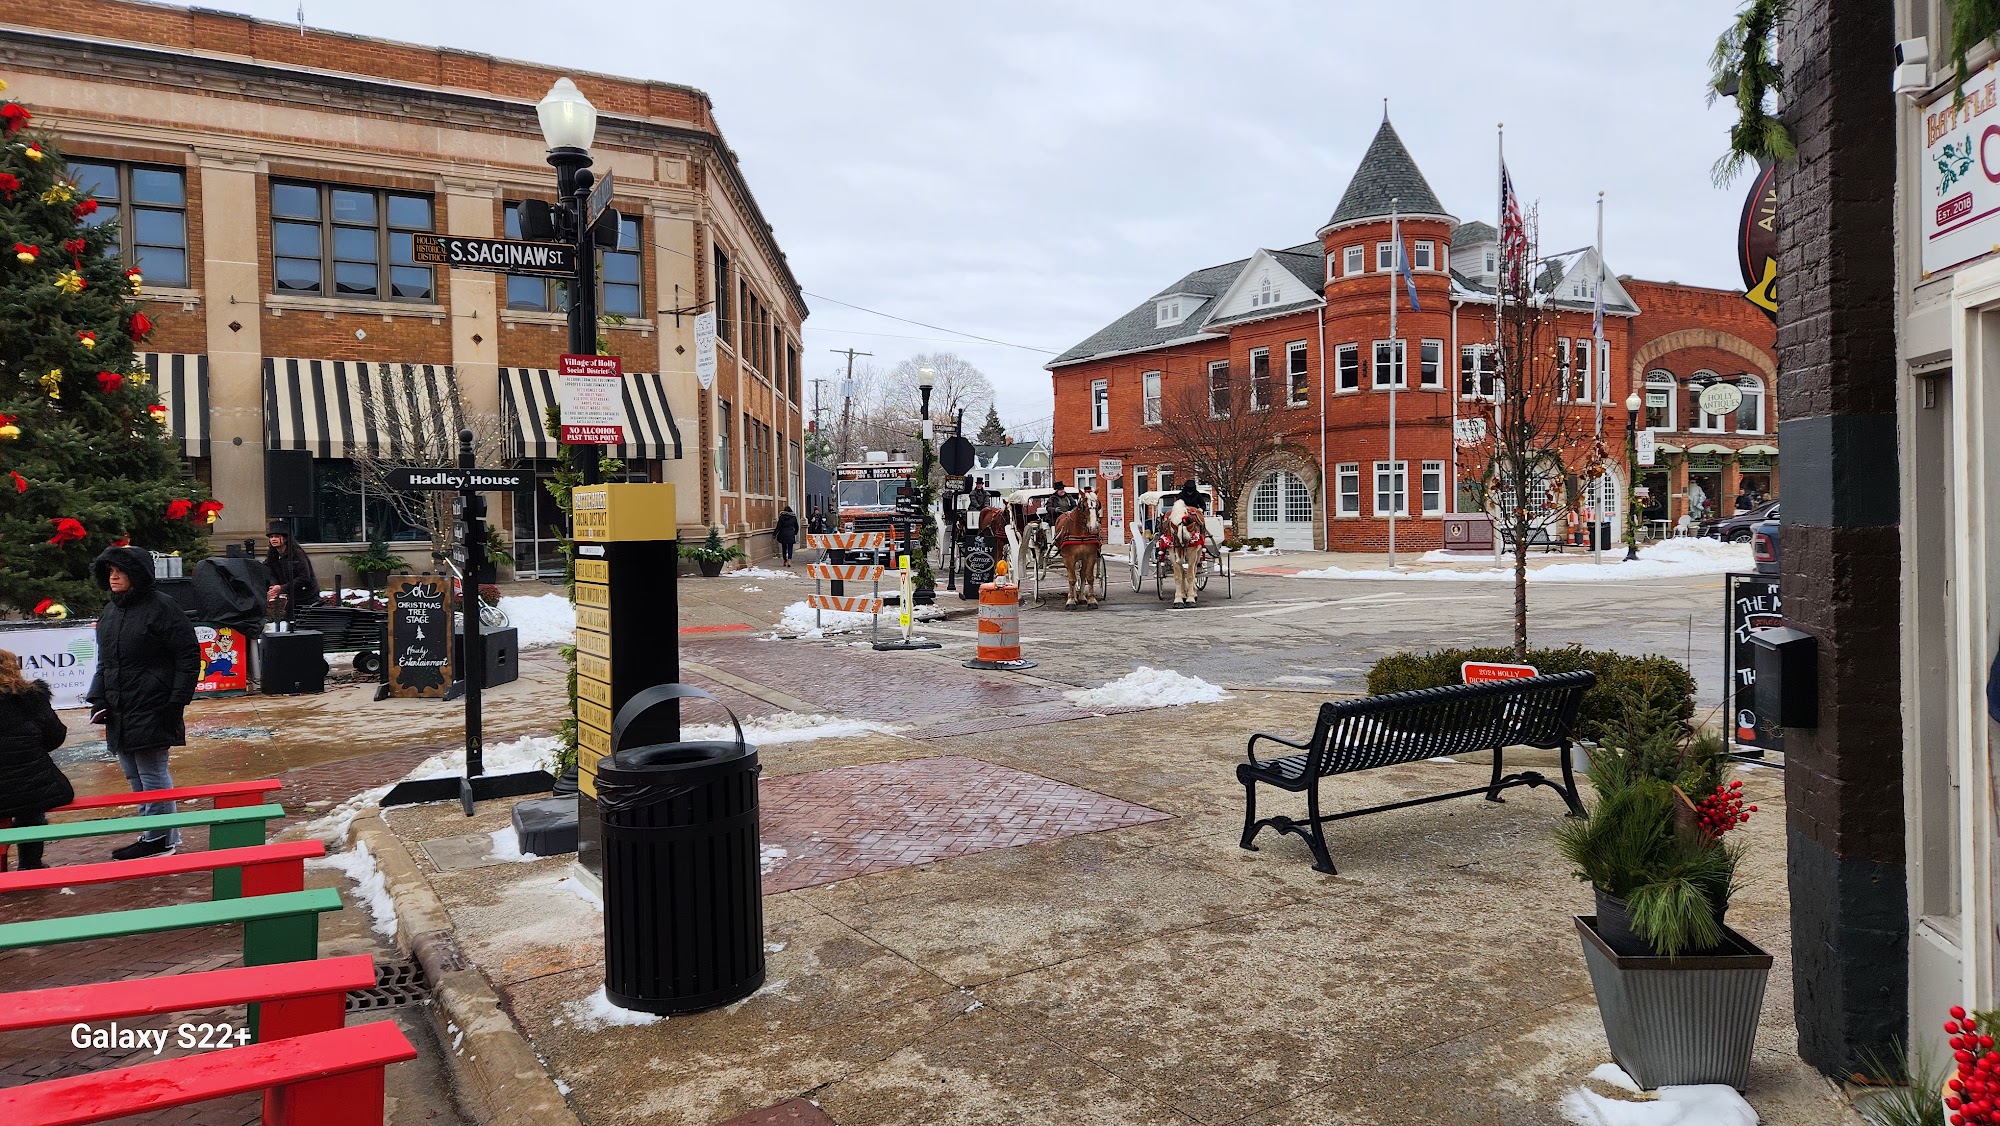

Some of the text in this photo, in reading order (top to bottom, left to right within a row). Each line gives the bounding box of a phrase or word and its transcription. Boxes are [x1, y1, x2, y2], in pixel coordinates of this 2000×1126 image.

[1927, 79, 1997, 149] BATTLE
[1954, 197, 1972, 216] 2018
[416, 236, 438, 245] HOLLY
[416, 244, 448, 254] HISTORICAL
[418, 254, 447, 262] DISTRICT
[564, 358, 589, 368] Village
[598, 360, 616, 368] Holly
[1708, 392, 1732, 401] HOLLY
[1704, 399, 1740, 409] ANTIQUES
[410, 473, 519, 488] Hadley House
[576, 512, 607, 526] SOCIAL DISTRICT
[1737, 596, 1768, 614] THE
[398, 655, 448, 667] Entertainment
[26, 670, 84, 678] ICHIGAN
[1737, 668, 1756, 685] TH
